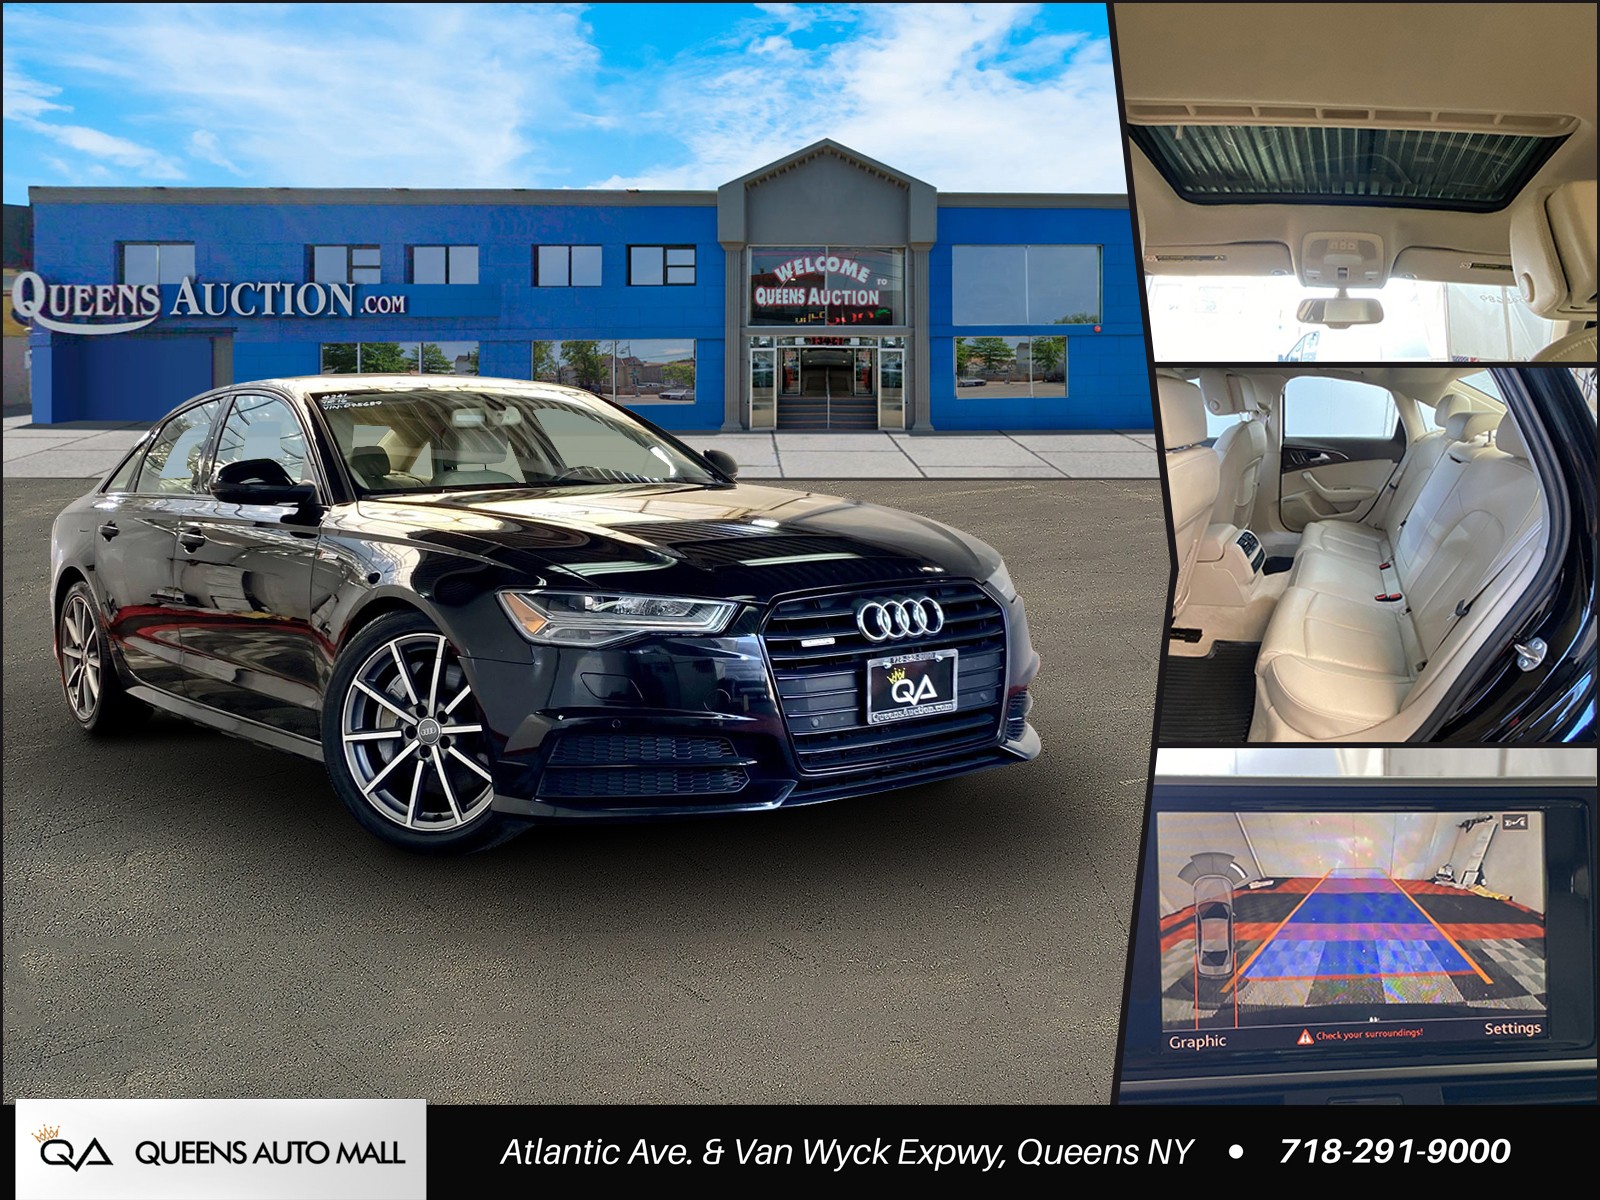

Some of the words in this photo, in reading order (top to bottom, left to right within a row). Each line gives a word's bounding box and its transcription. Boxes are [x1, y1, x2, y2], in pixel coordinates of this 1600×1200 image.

[774, 256, 871, 284] WELCOME
[12, 271, 160, 335] QUEENS
[170, 276, 356, 316] AUCTION
[360, 296, 405, 314] .COM
[755, 287, 806, 306] QUEENS
[809, 288, 880, 306] AUCTION
[1316, 1031, 1342, 1041] Check
[1344, 1032, 1363, 1041] your
[1364, 1028, 1424, 1041] surroundings!
[1485, 1021, 1542, 1036] Settings
[1169, 1034, 1227, 1051] Graphic
